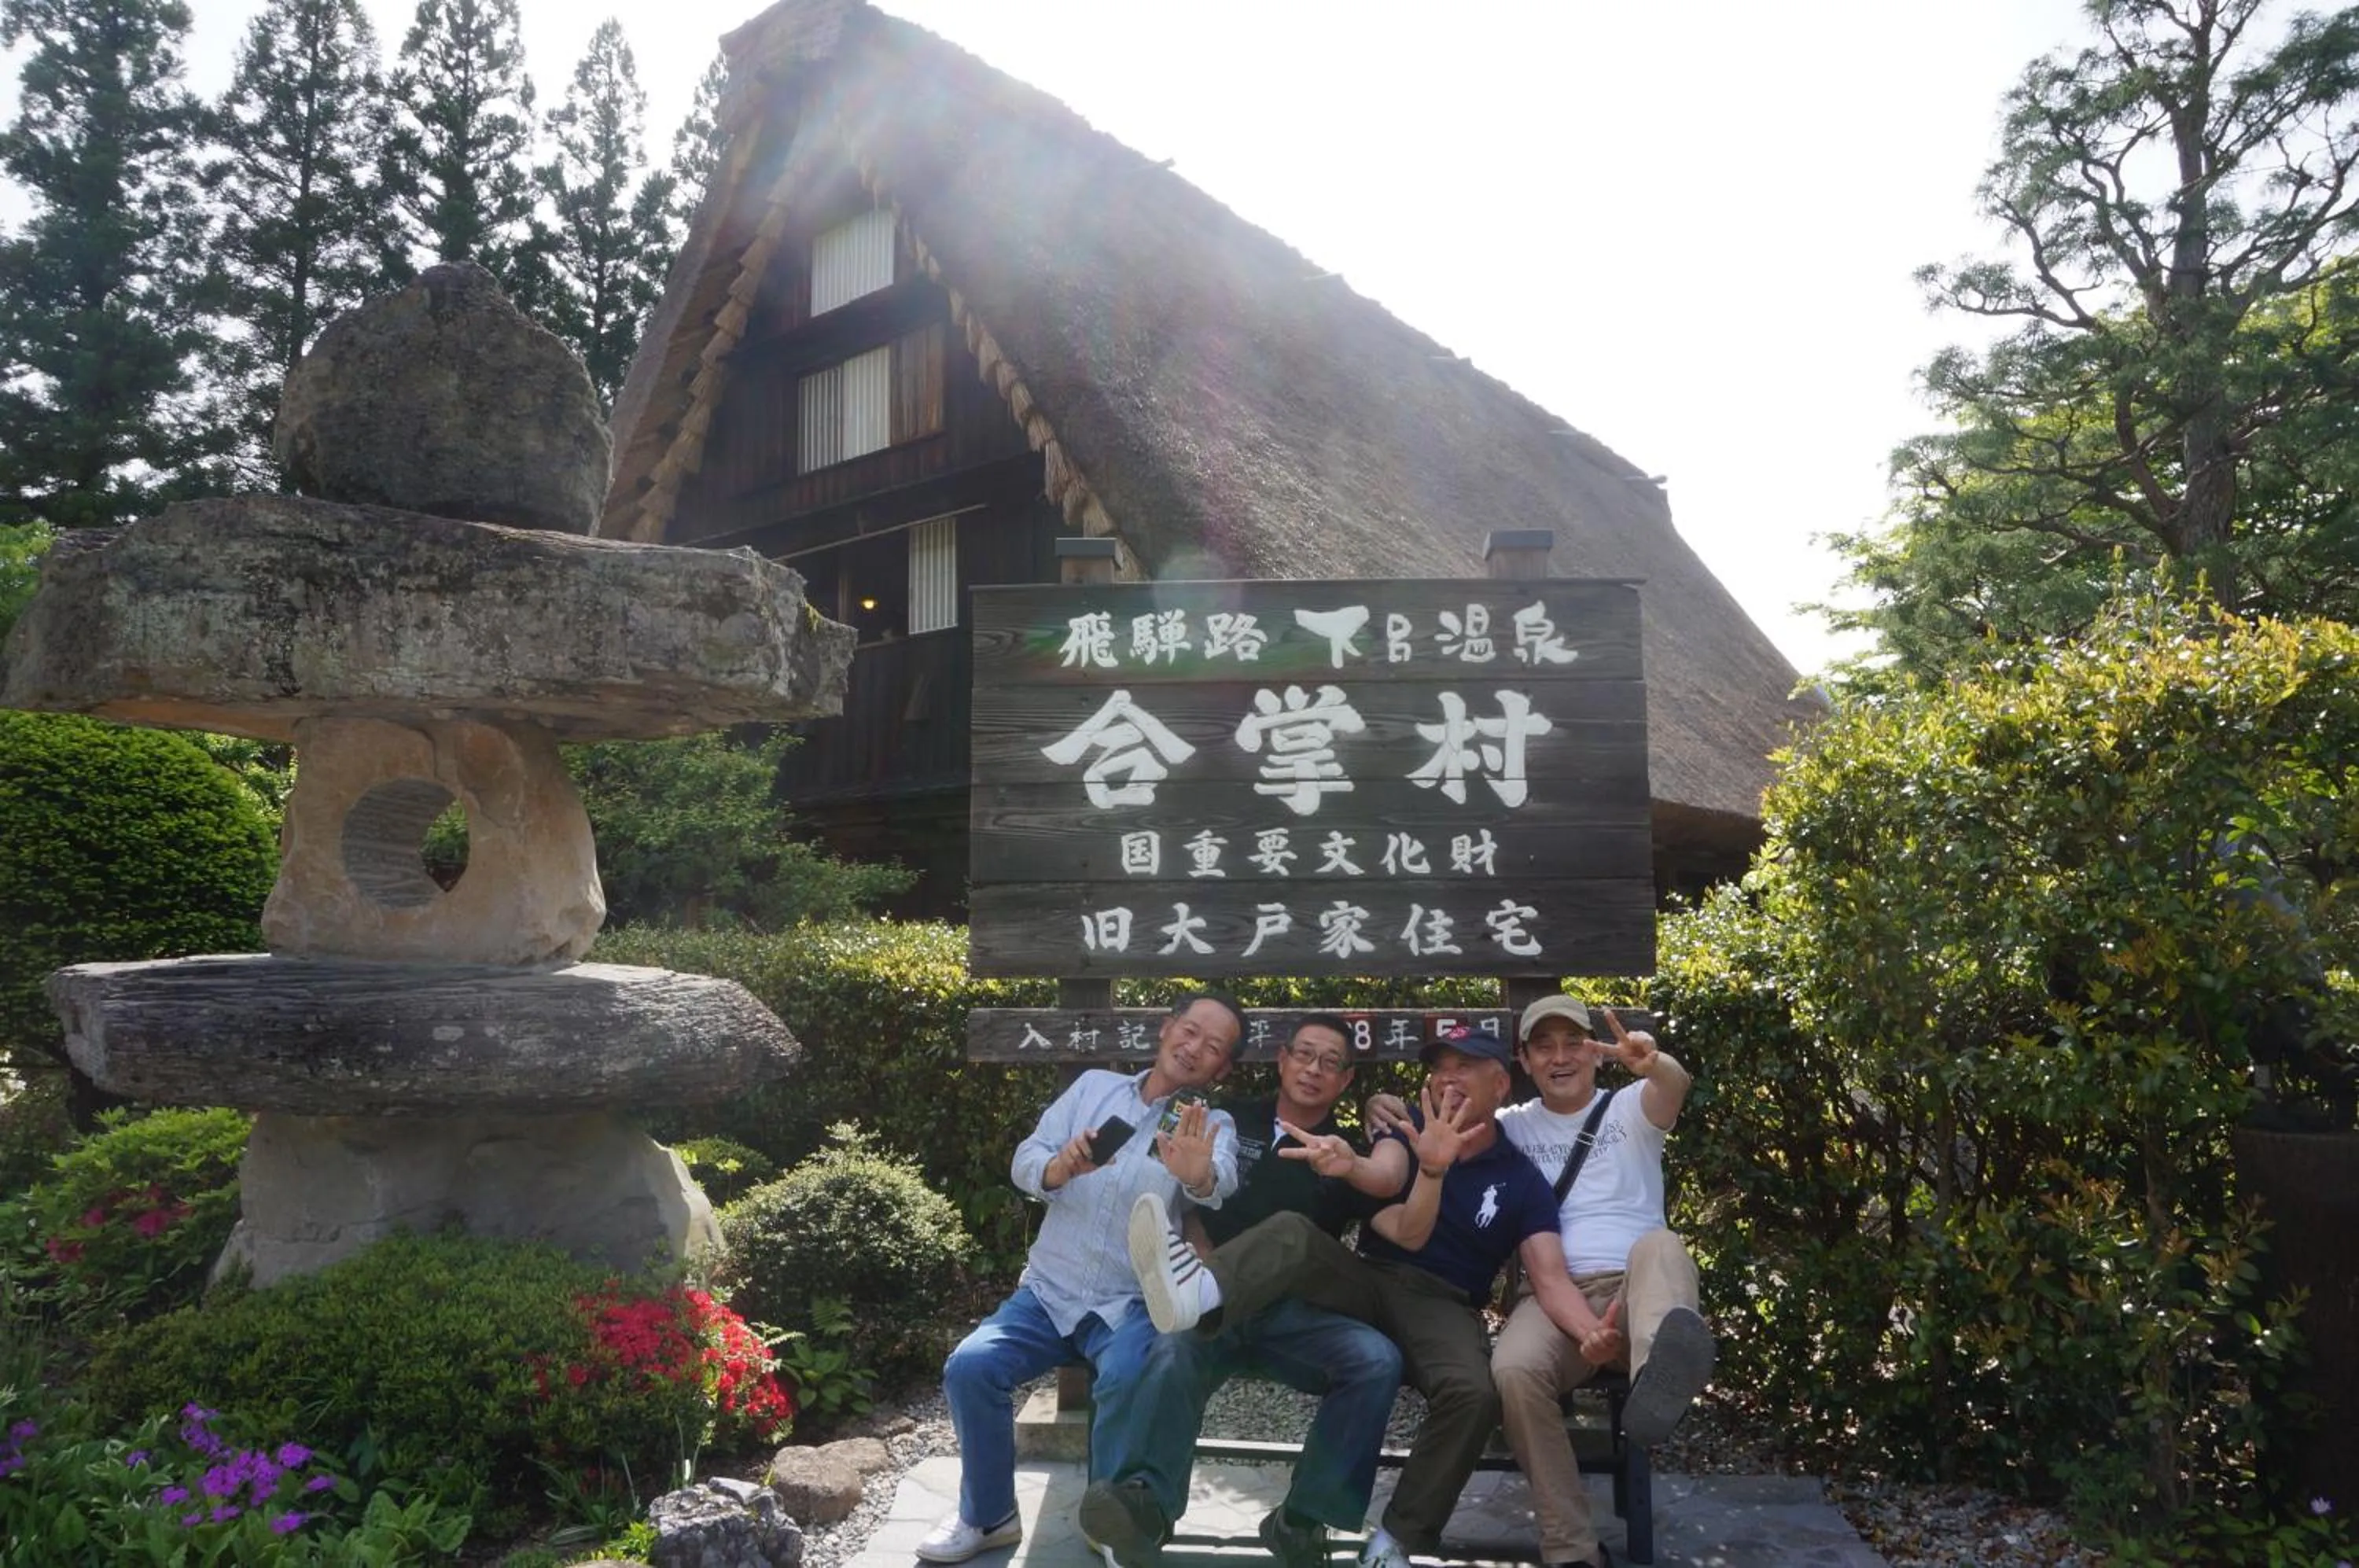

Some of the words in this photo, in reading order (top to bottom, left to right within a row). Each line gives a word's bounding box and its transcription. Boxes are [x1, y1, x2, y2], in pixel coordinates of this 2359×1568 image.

[1040, 686, 1552, 815] 合掌村
[1121, 829, 1498, 877] 国重要文化財
[1081, 899, 1542, 959] 旧大戸家住宅
